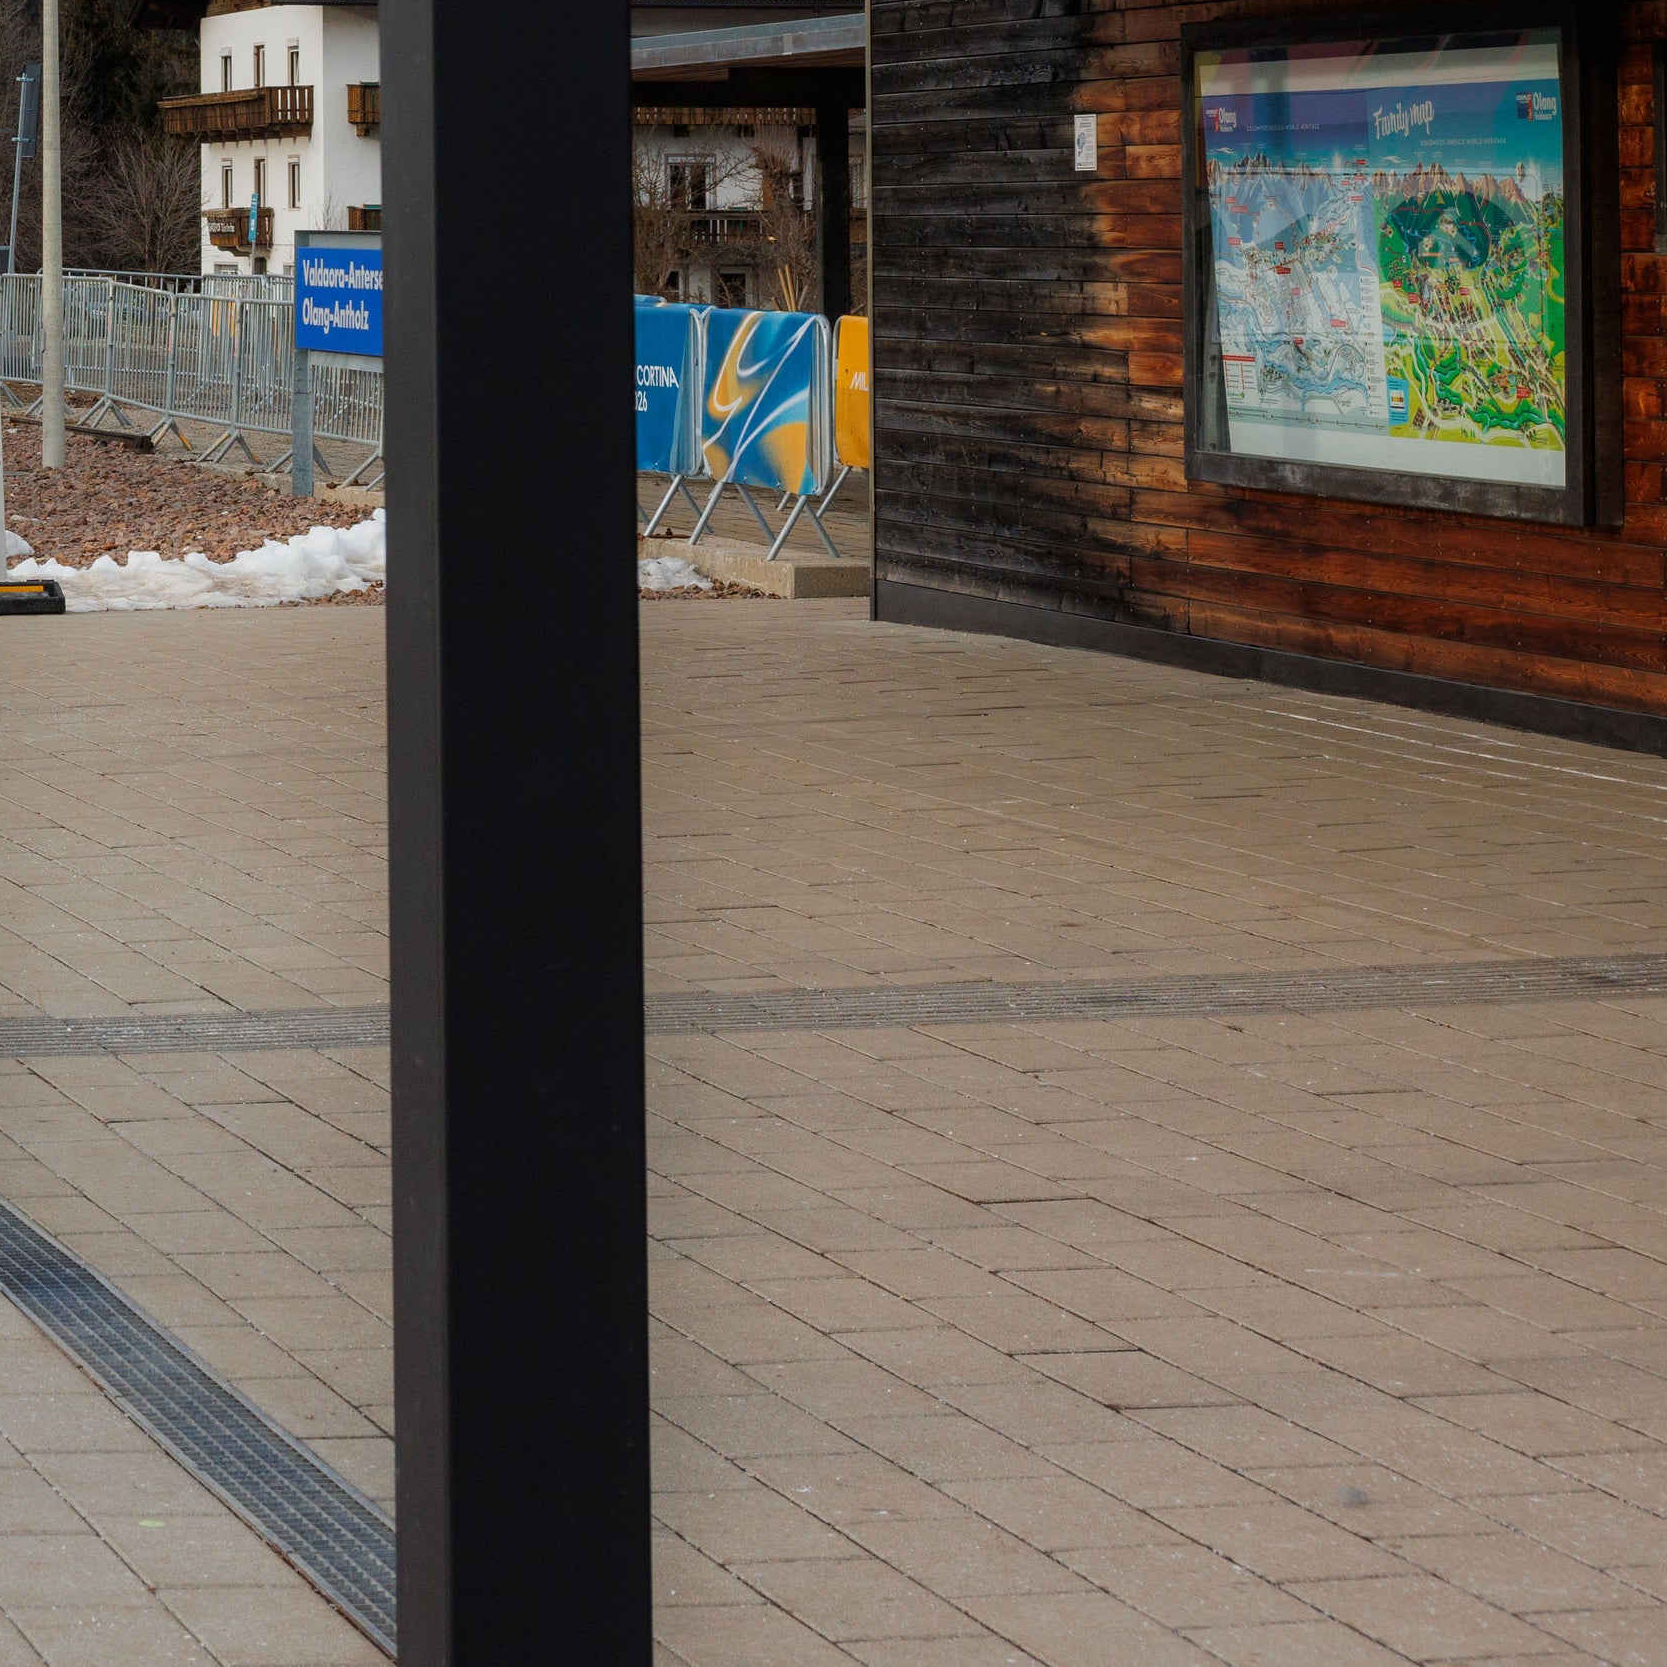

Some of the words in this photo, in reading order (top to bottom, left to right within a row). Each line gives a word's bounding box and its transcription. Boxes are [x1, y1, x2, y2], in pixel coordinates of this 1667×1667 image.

[1533, 92, 1557, 116] Olang
[1218, 107, 1237, 128] Olang
[1372, 101, 1409, 140] Family
[1410, 100, 1434, 135] map
[302, 297, 369, 334] Olang-Antholz
[637, 364, 679, 389] CORTINA
